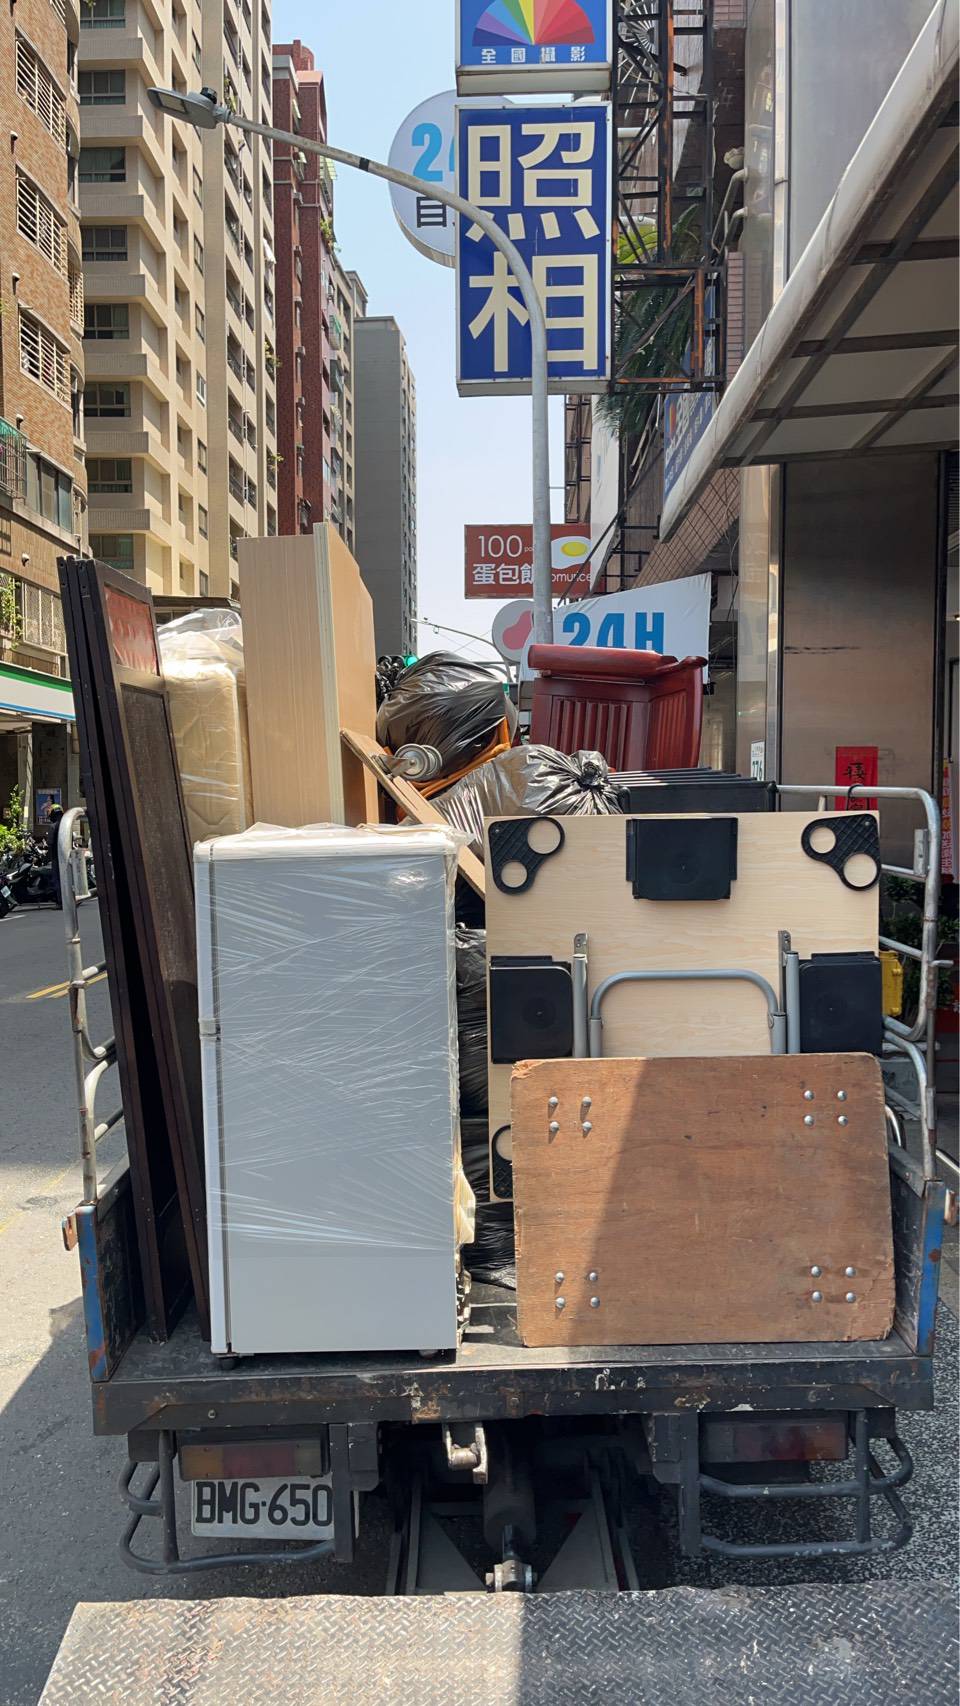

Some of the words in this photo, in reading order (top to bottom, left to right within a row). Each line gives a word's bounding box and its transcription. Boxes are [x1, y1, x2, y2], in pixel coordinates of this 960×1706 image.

[411, 122, 455, 182] 2
[465, 121, 600, 372] 照相
[478, 535, 522, 558] 100
[563, 612, 664, 655] 24H
